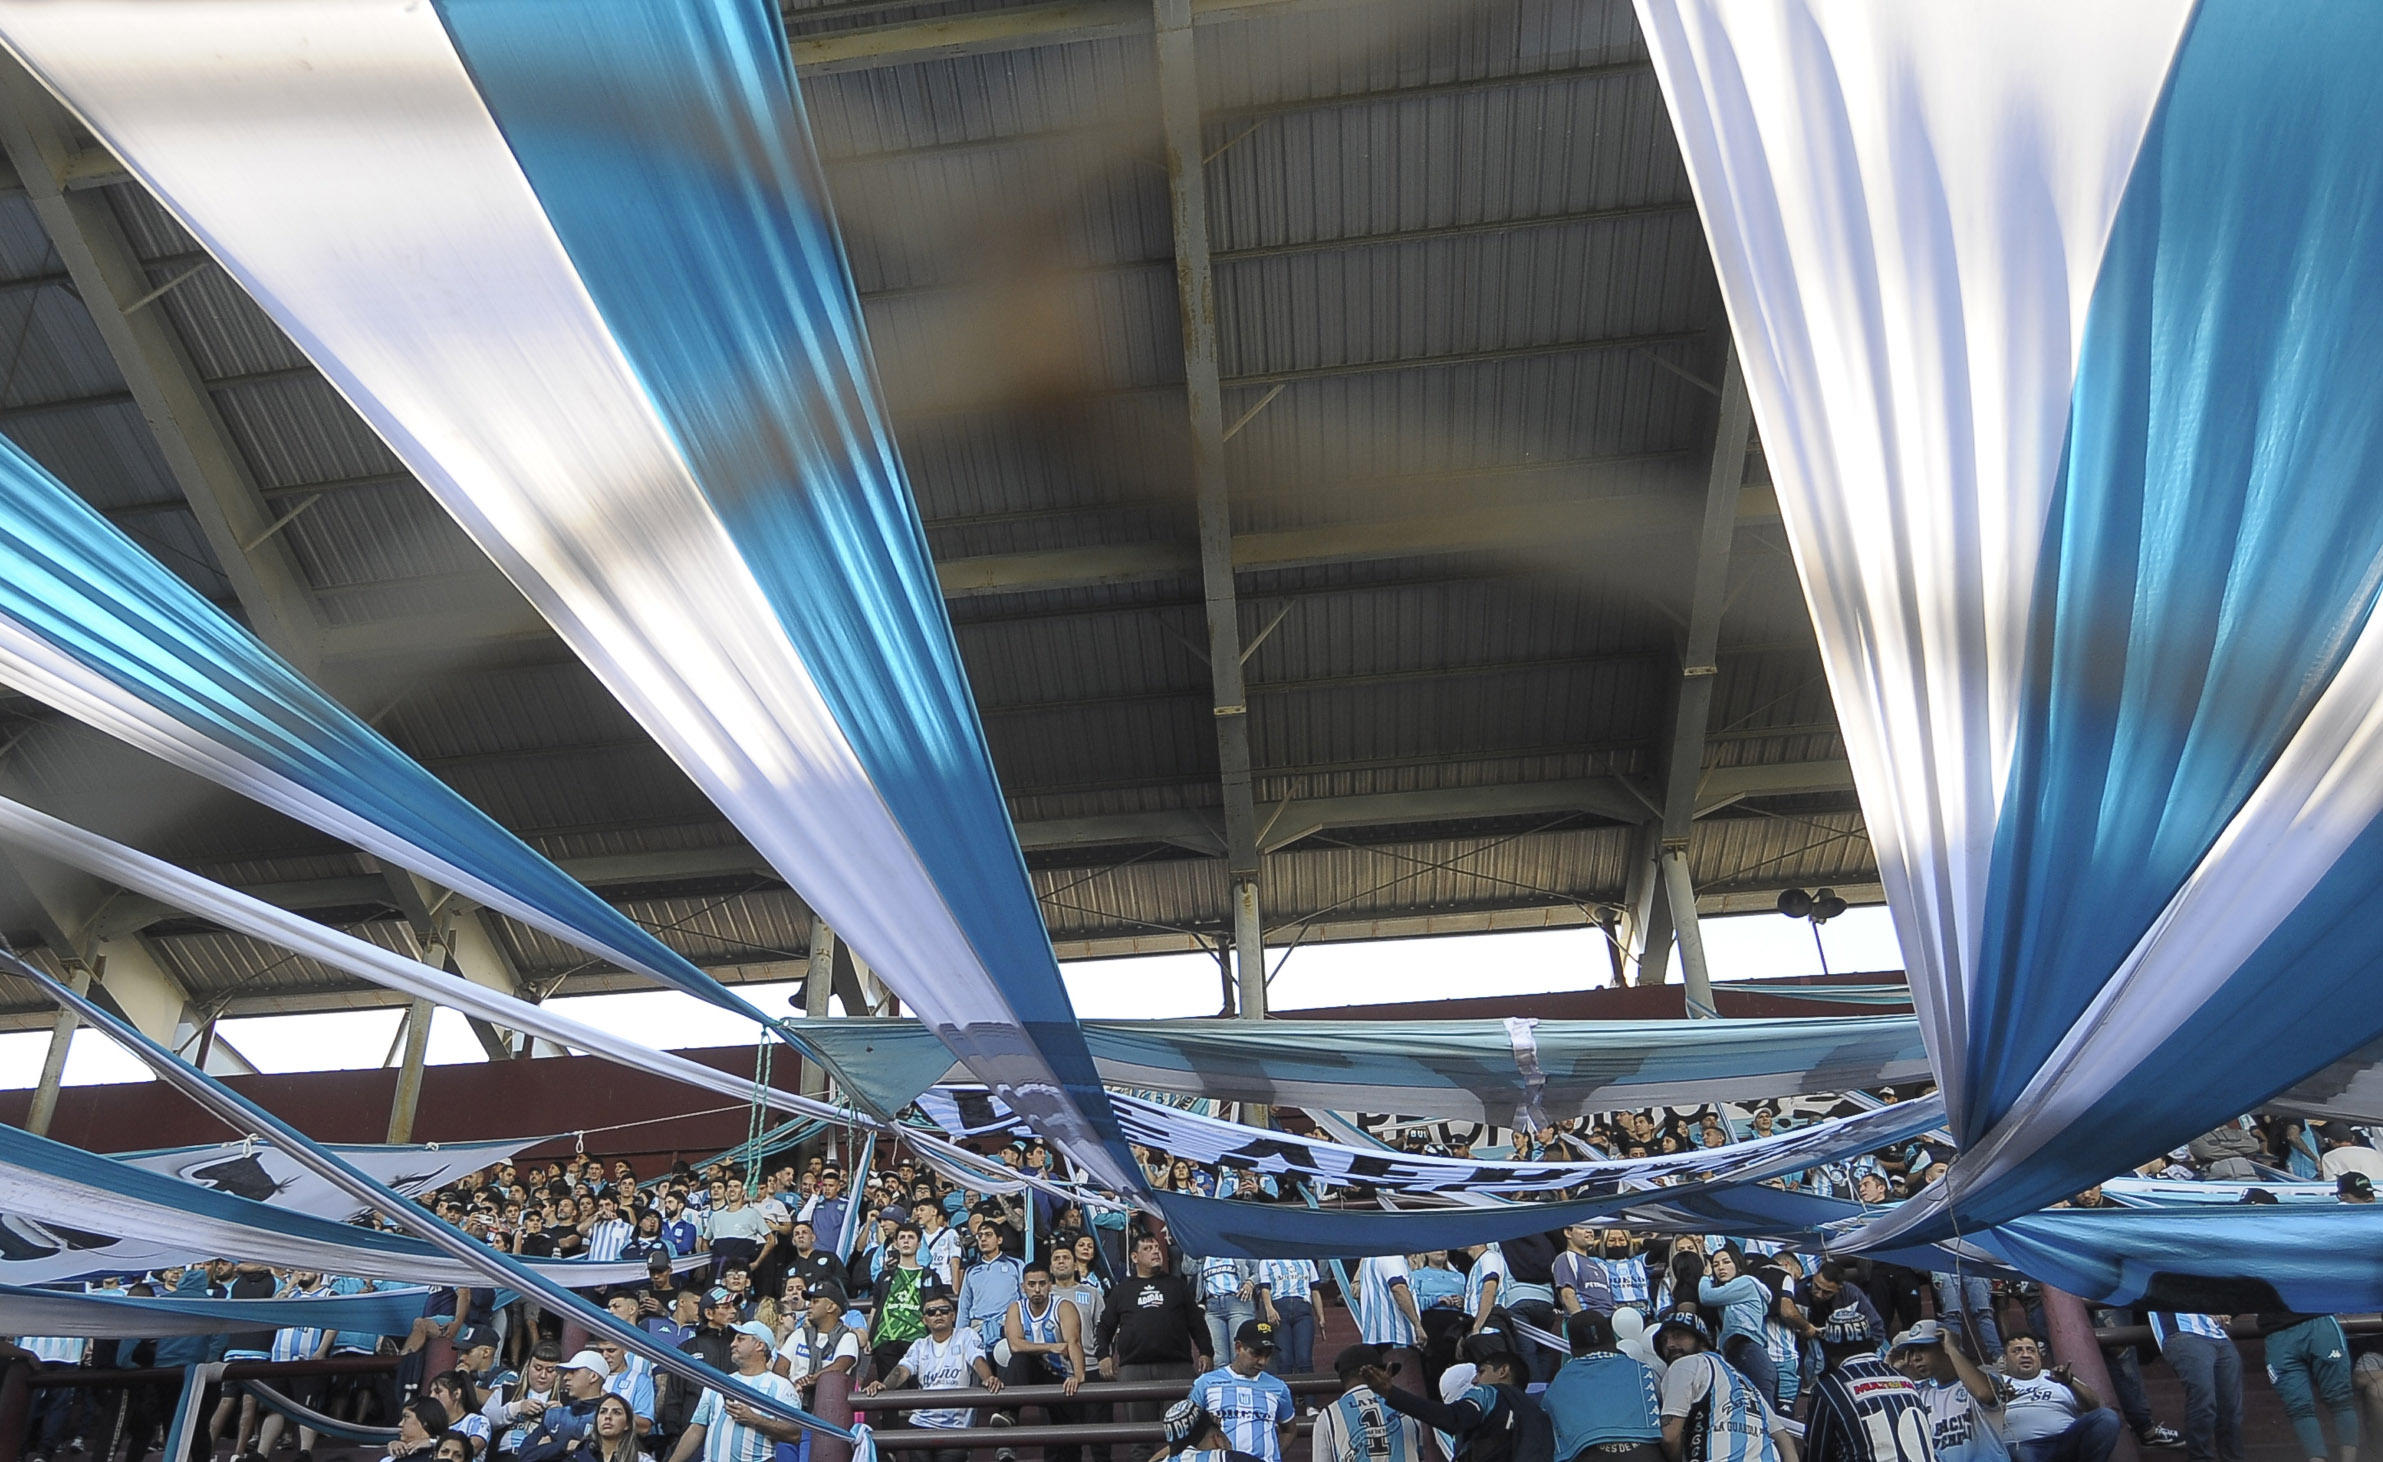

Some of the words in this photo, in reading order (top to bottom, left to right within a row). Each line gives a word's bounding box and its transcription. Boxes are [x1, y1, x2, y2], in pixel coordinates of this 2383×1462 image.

[1138, 1293, 1164, 1305] ADIDAS
[1675, 1312, 1693, 1326] DE
[1844, 1322, 1862, 1341] DE
[2031, 1391, 2052, 1401] SB
[1173, 1418, 1190, 1439] DE
